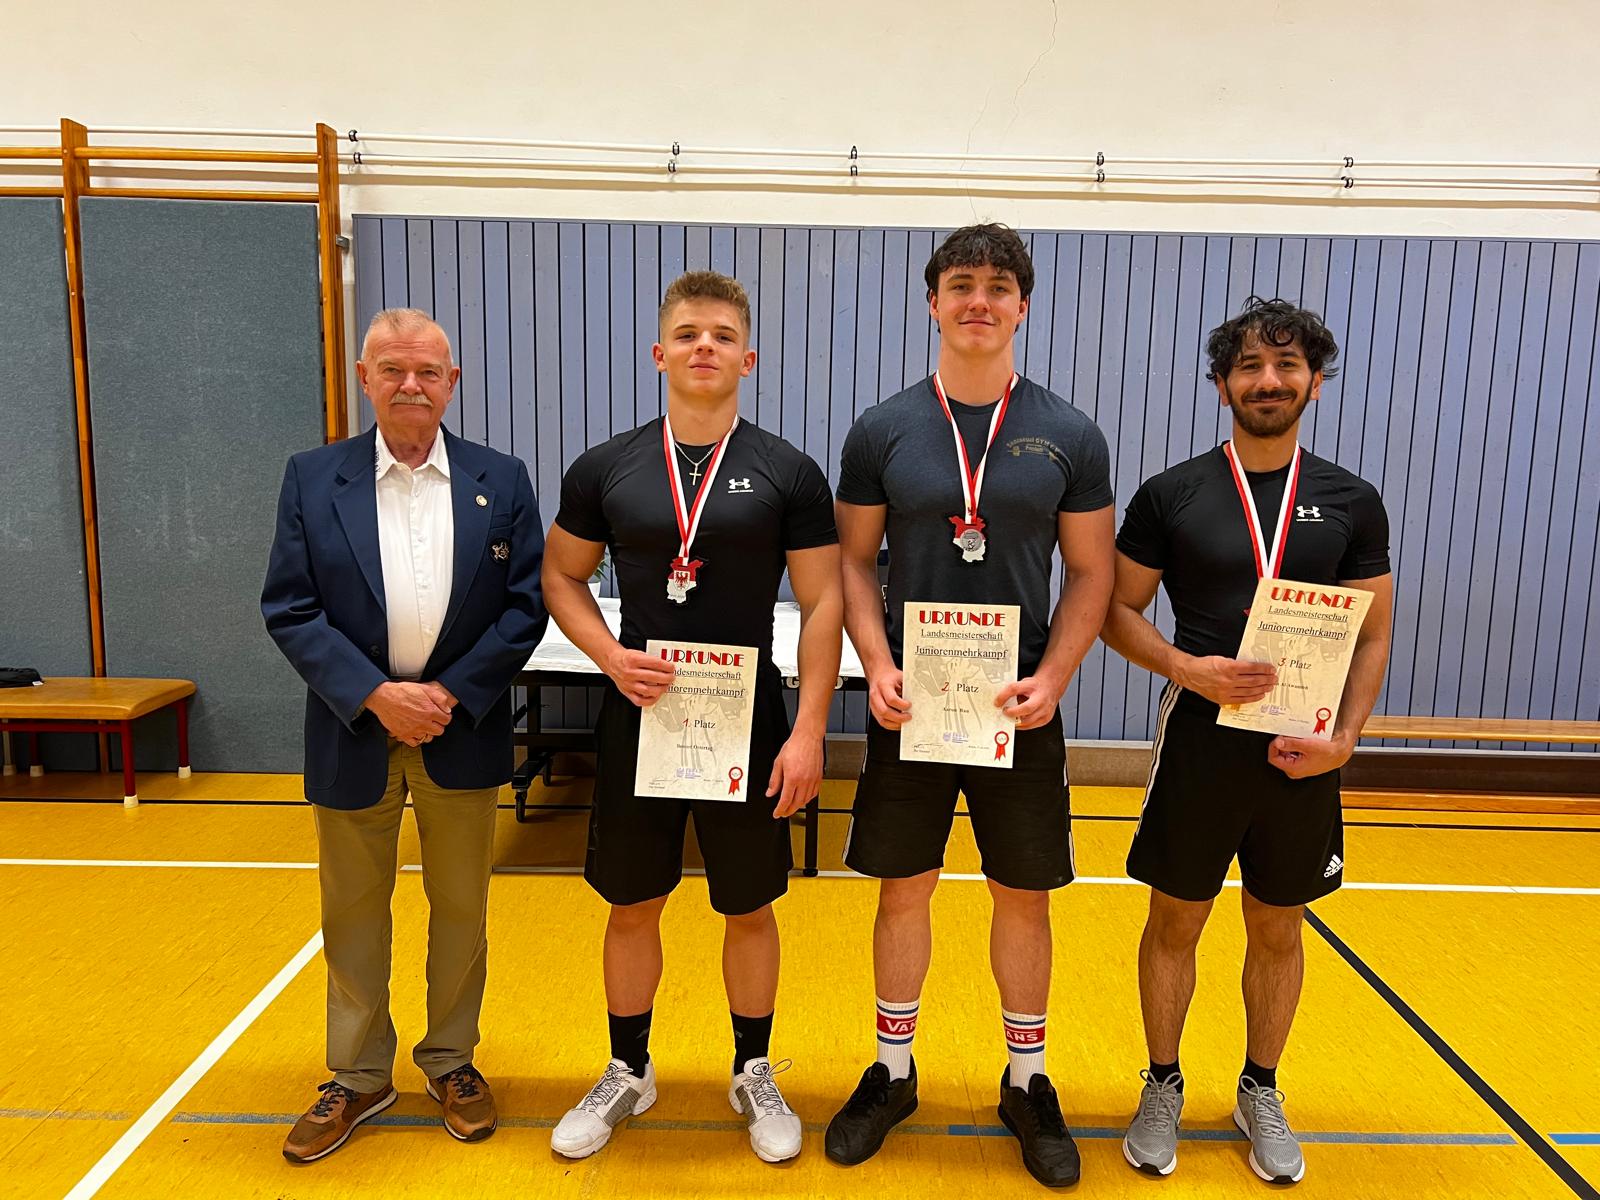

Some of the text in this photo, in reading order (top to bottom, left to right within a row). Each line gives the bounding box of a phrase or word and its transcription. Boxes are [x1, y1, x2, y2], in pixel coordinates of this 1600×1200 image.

[1270, 586, 1358, 611] URKUNDE
[919, 610, 1006, 626] URKUNDE
[1268, 605, 1349, 623] Landesmeisterschaft
[921, 629, 1004, 641] Landesmeisterschaft
[1257, 621, 1350, 640] Juniorenmehrkampf
[661, 648, 745, 667] URKUNDE
[915, 645, 1009, 660] Juniorenmehrkampf
[1289, 659, 1312, 670] Platz
[956, 683, 979, 694] Platz
[694, 719, 716, 729] Platz
